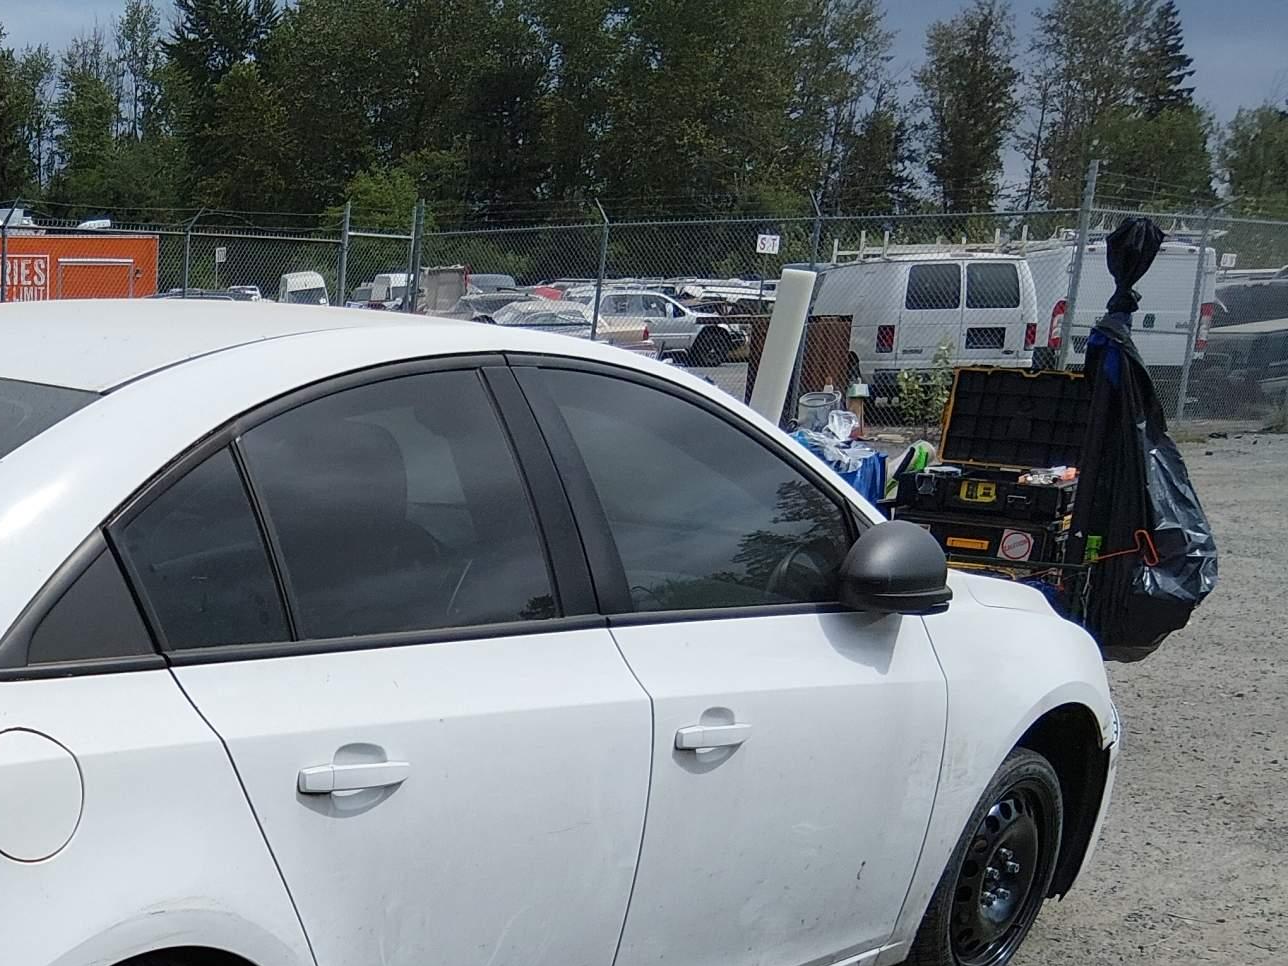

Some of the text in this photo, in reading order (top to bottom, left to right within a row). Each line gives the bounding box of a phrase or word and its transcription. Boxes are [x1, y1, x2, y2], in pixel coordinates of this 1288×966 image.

[759, 236, 777, 251] S T
[13, 286, 45, 302] LIMIT
